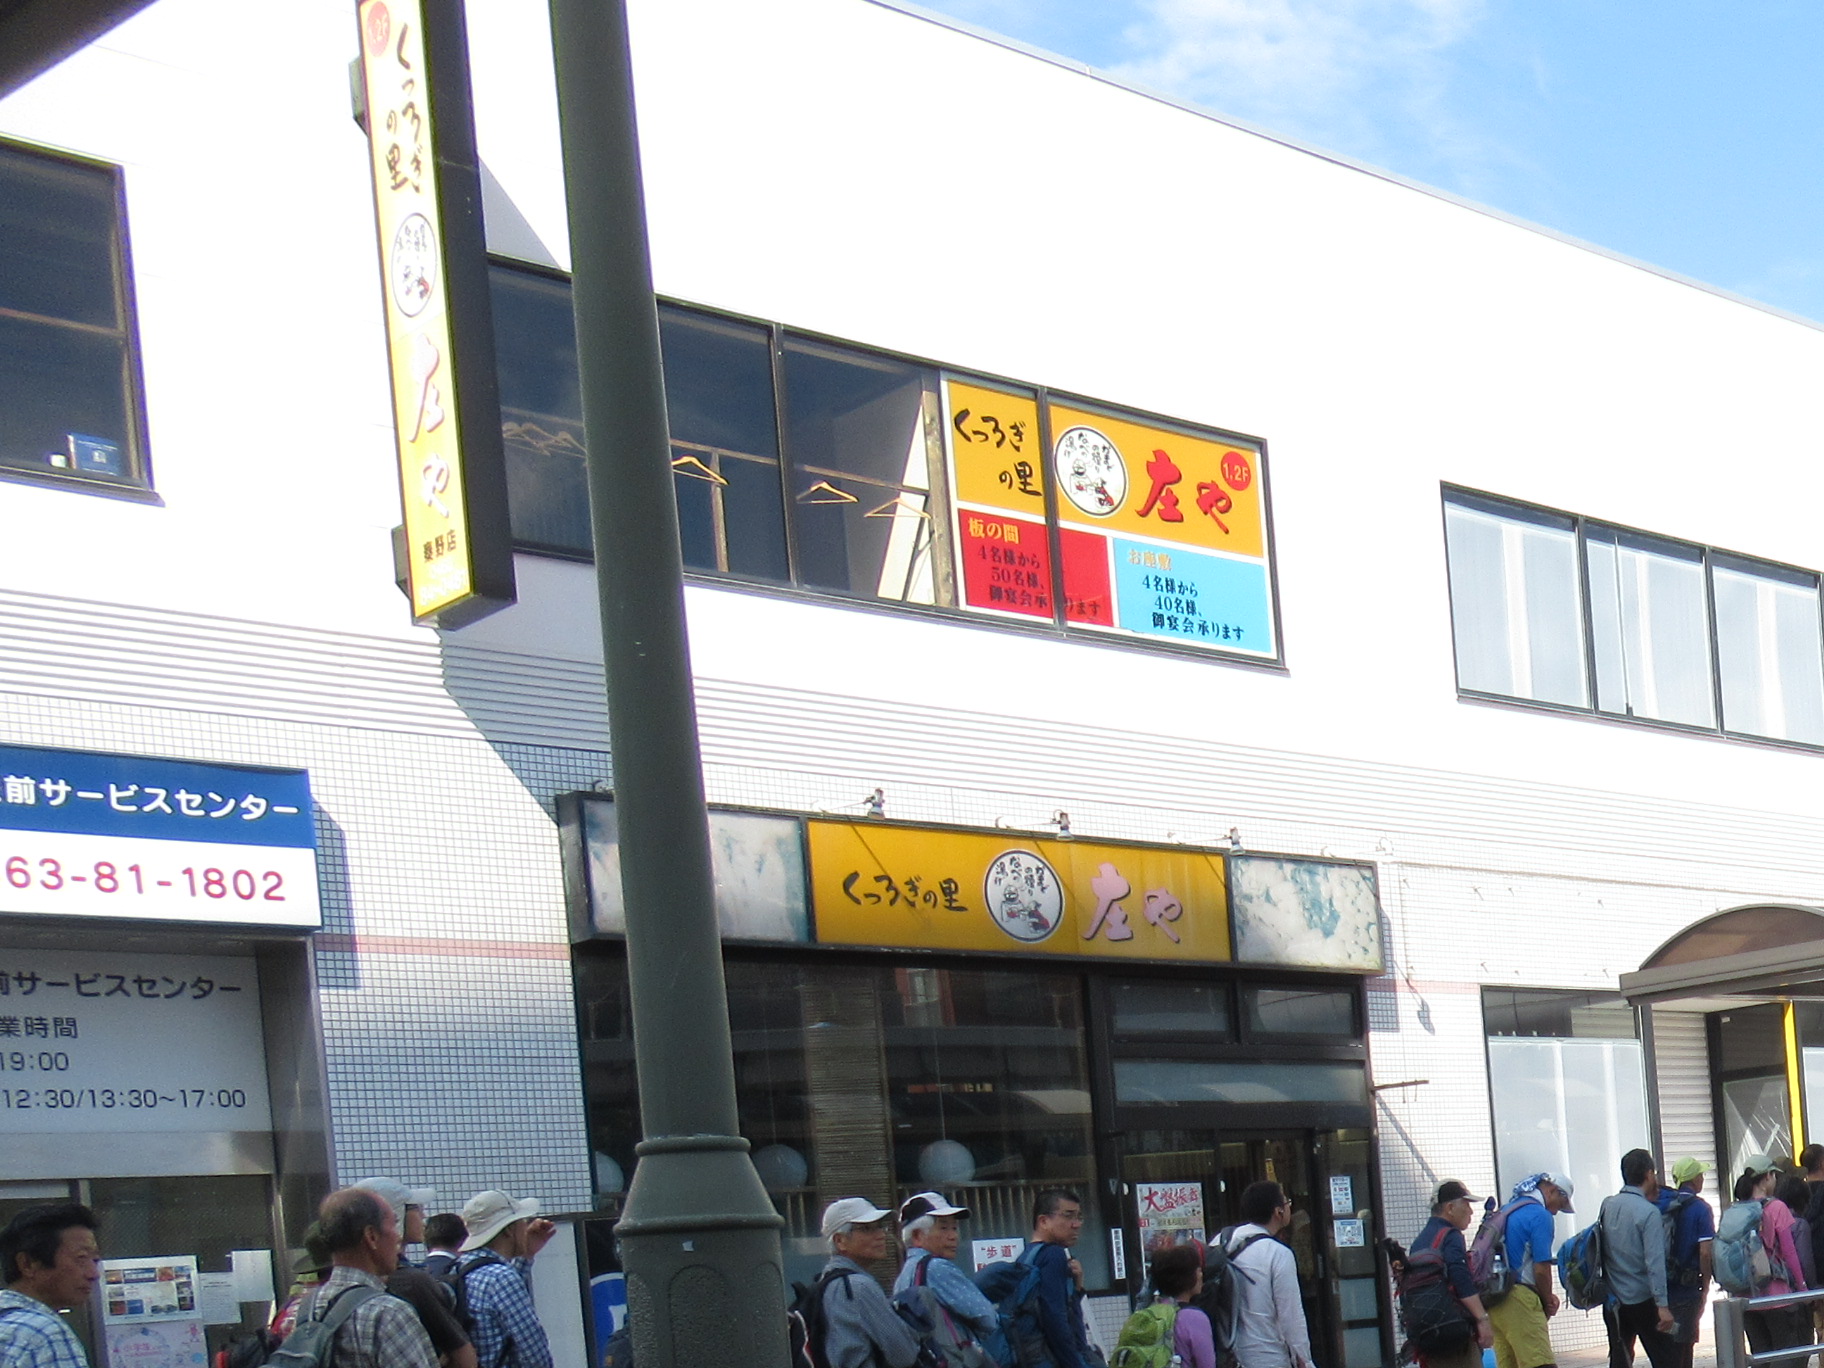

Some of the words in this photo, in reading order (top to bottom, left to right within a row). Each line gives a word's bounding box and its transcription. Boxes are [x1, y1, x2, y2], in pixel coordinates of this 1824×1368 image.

[397, 23, 422, 193] くつろぎ
[386, 110, 408, 191] の里
[954, 409, 1026, 452] くつろぎ
[1000, 461, 1042, 497] の里
[1223, 462, 1250, 482] 1.2F
[1135, 449, 1233, 535] 庄や
[968, 517, 1020, 544] 板の間
[978, 545, 1040, 569] 4名様から
[1128, 549, 1172, 571] お座敷
[991, 566, 1045, 590] 50名様、
[1142, 574, 1199, 598] 4名様から
[1154, 595, 1202, 617] 40名様、
[1152, 611, 1245, 641] 御宴会承ります
[0, 775, 299, 821] 前サービスセンター
[5, 856, 286, 902] 63-81-1802
[843, 871, 968, 912] くつろぎの里
[1081, 862, 1184, 944] 庄や
[0, 970, 242, 1000] サービスセンター
